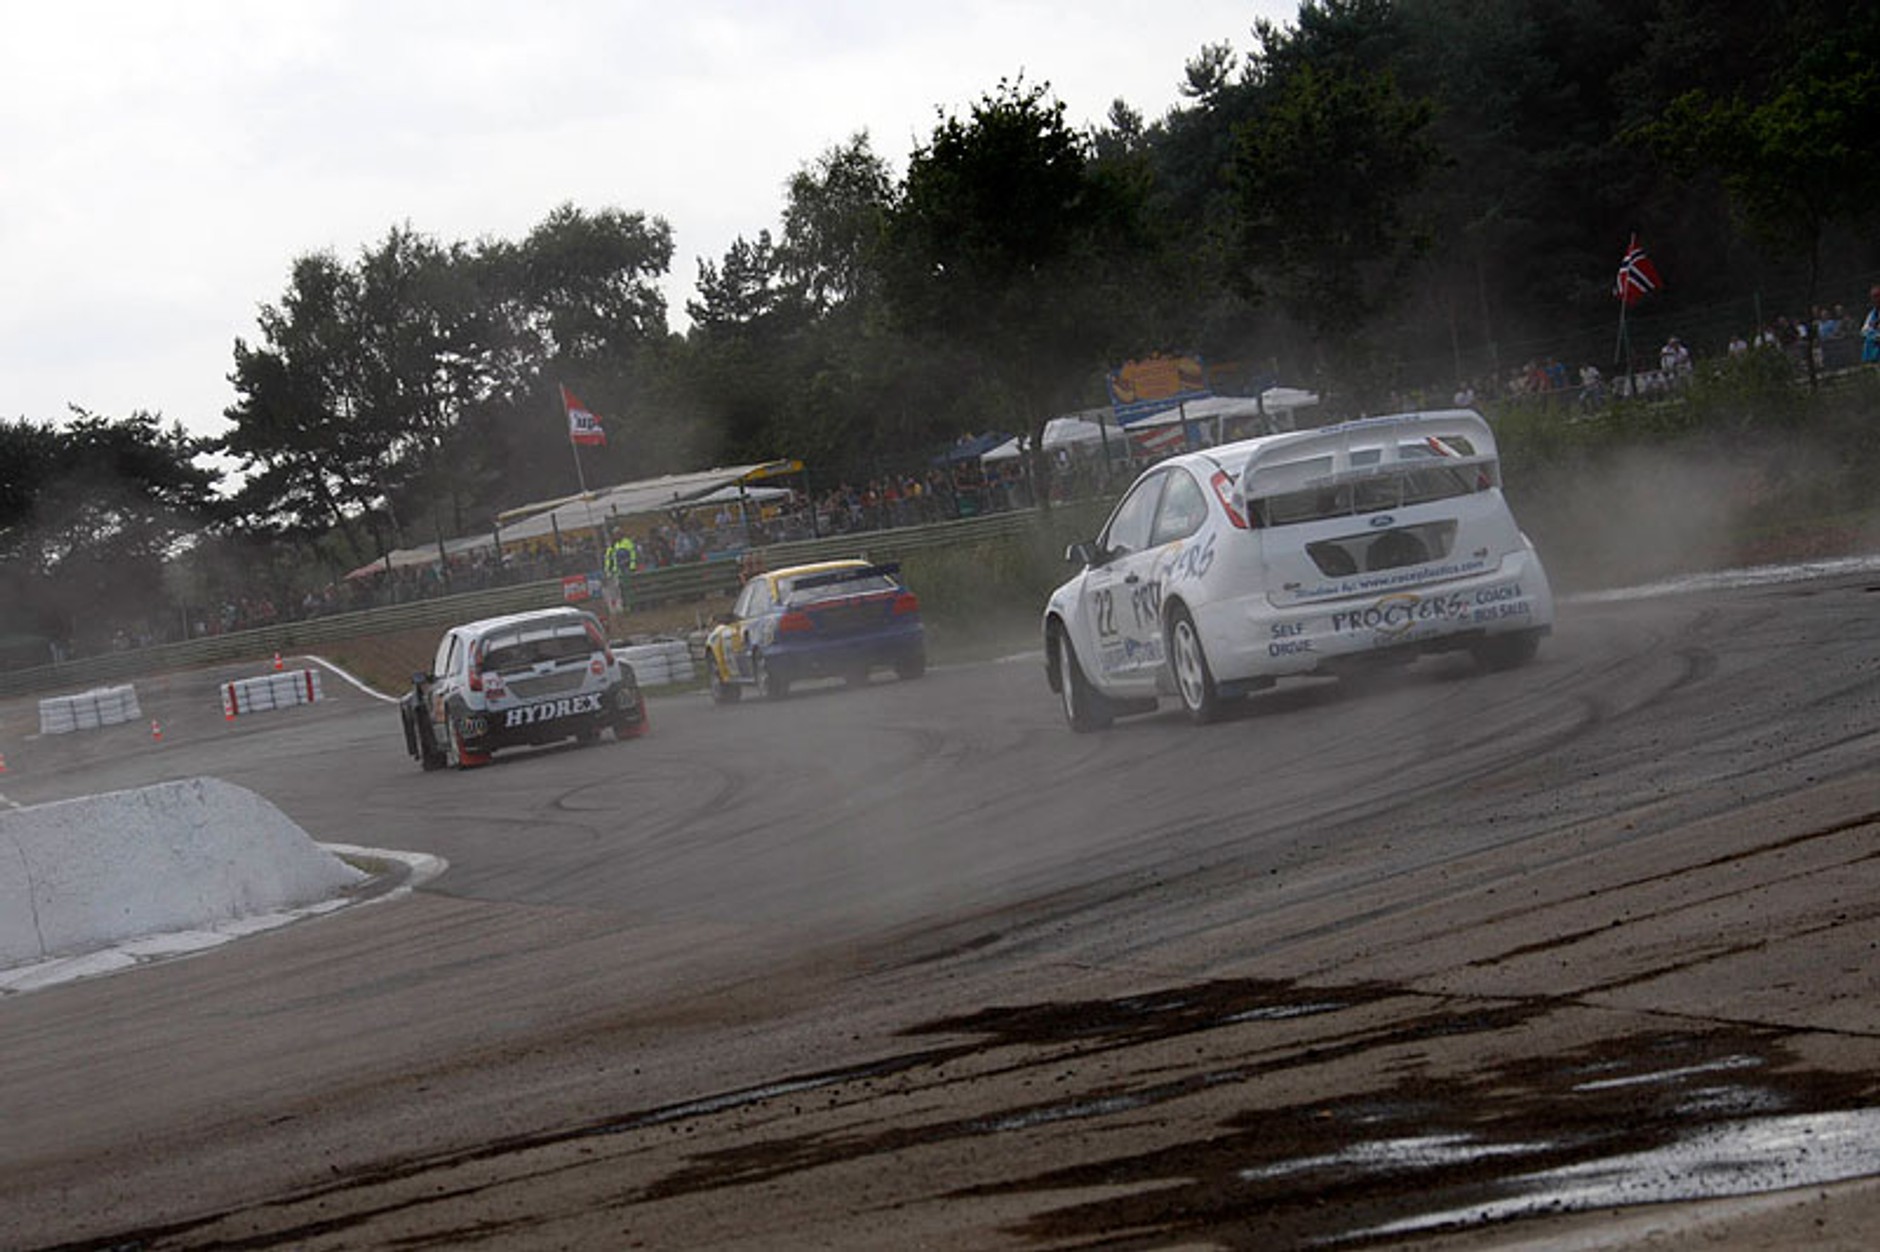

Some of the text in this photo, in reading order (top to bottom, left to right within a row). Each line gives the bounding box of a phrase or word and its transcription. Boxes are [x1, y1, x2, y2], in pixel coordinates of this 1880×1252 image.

[1096, 589, 1118, 637] 22
[1271, 622, 1304, 640] SELF
[1332, 593, 1464, 632] PROCTERS
[504, 692, 603, 728] HYDREX
